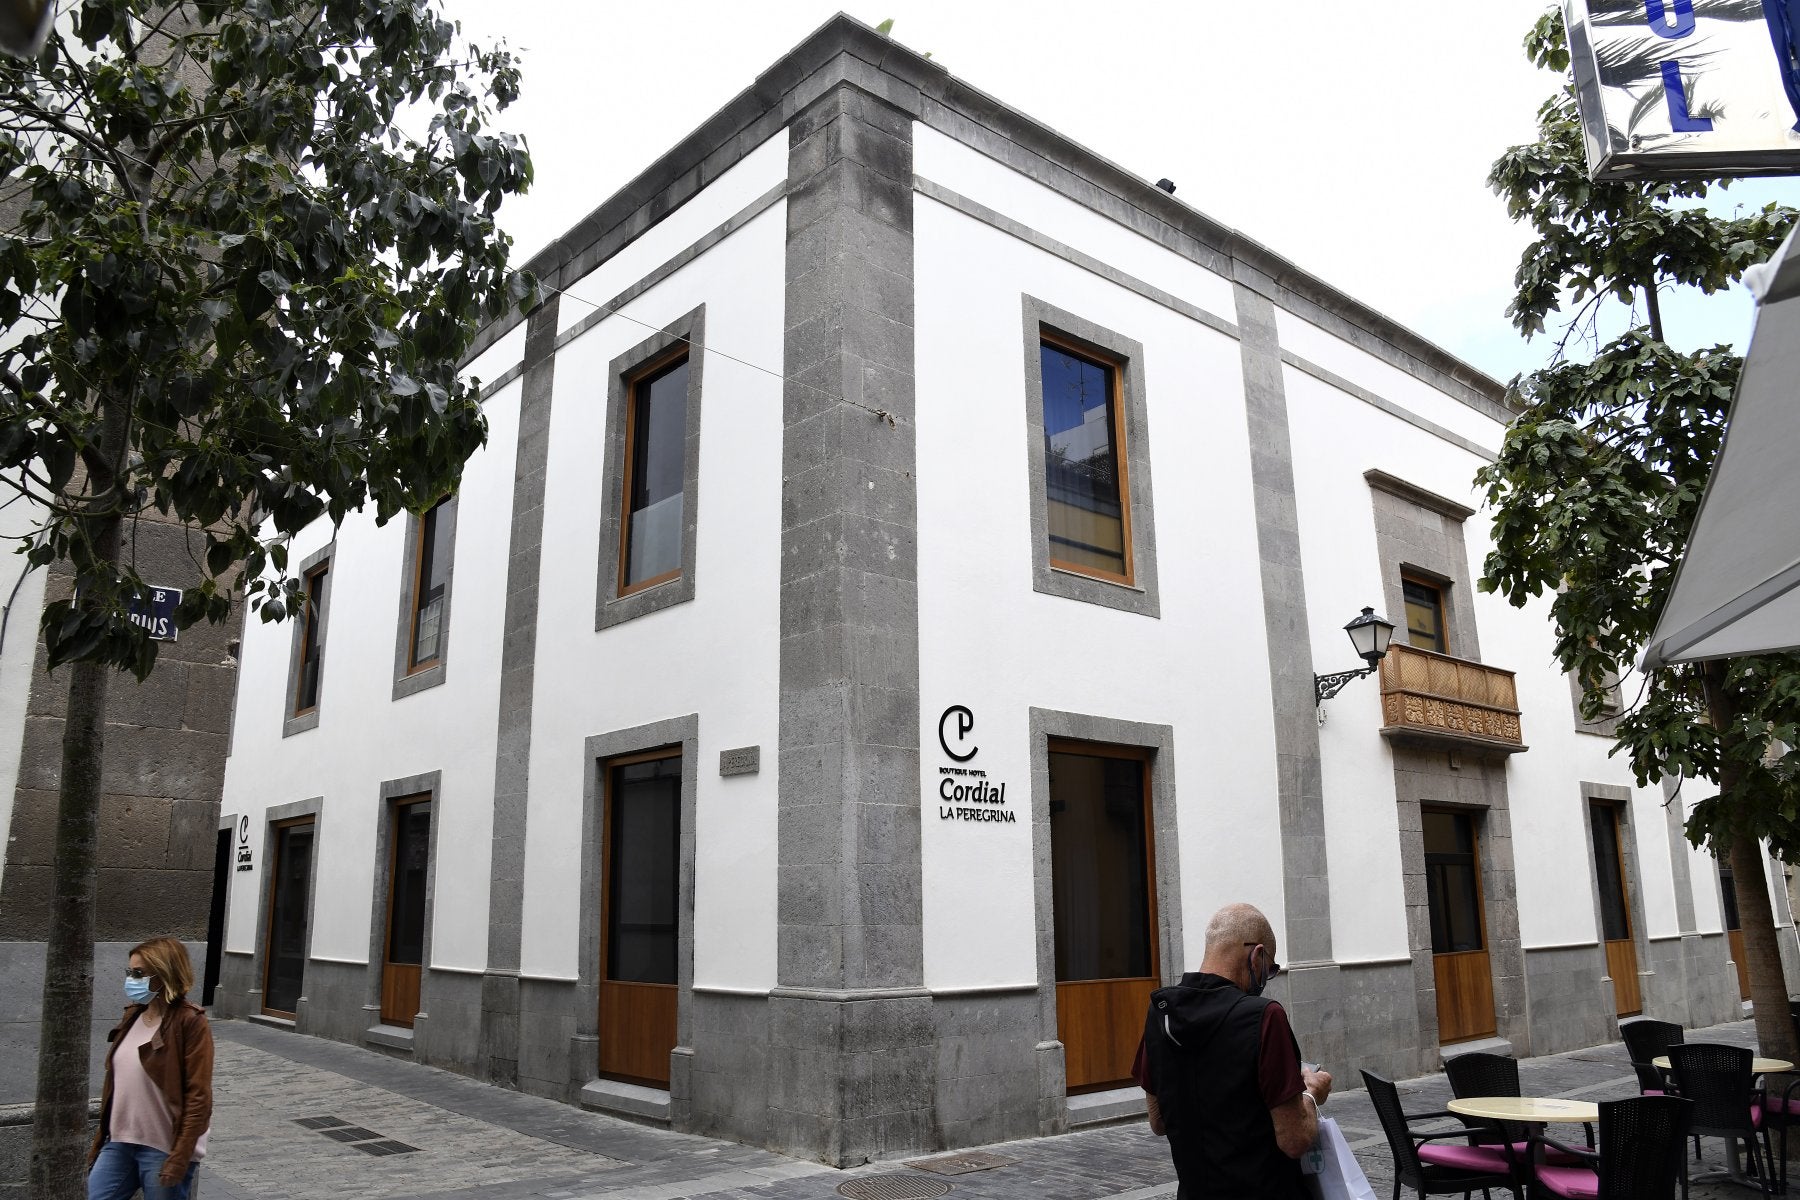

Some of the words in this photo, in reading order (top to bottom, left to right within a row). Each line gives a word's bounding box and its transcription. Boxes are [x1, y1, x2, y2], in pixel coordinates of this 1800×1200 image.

[939, 767, 967, 776] BOUTIQUE
[969, 769, 987, 777] HOTEL
[940, 778, 1005, 804] Cordial
[940, 806, 954, 819] LA
[956, 807, 1016, 823] PEREGRINA
